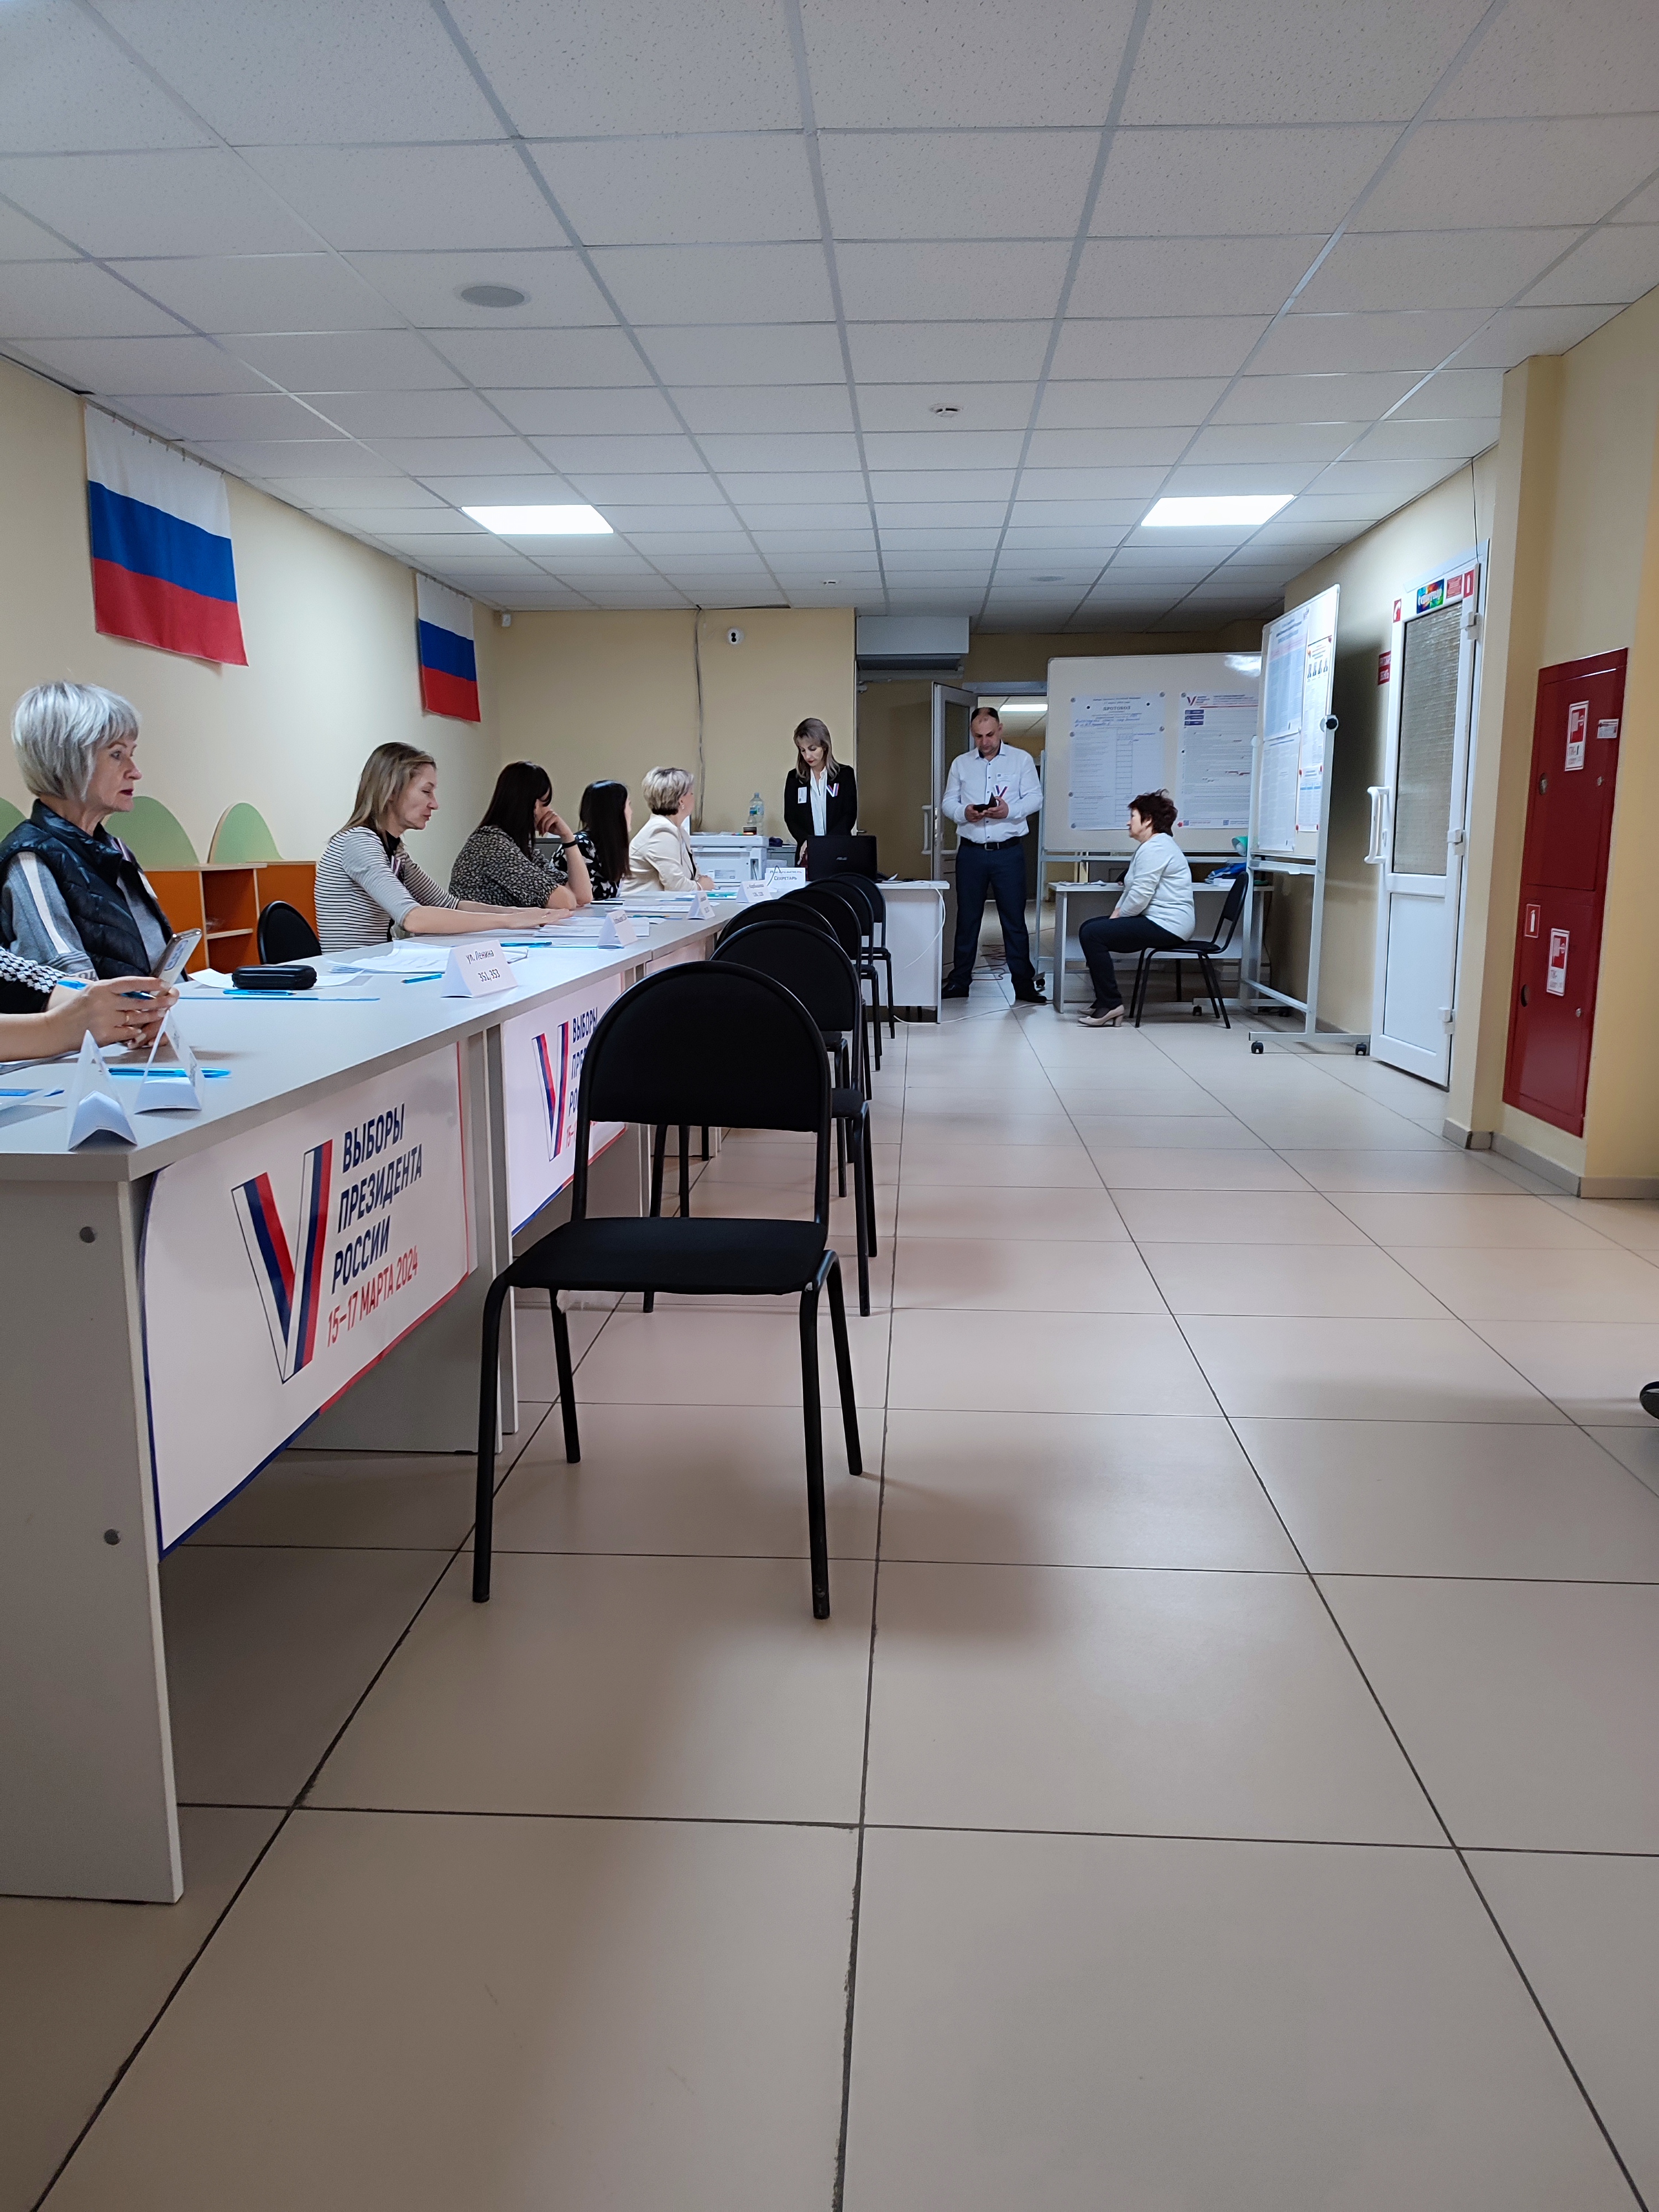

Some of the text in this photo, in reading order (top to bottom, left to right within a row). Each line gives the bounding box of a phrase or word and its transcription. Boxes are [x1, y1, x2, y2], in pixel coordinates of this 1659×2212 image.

[478, 968, 500, 982] 351,353
[572, 1006, 598, 1044] ВЫБОРЫ
[342, 1102, 405, 1174] ВЫБОРЫ
[337, 1142, 422, 1234] ПРЕЗИДЕНТА
[331, 1214, 391, 1296] РОССИИ
[359, 1263, 394, 1322] МАРТА
[395, 1245, 418, 1292] 2024
